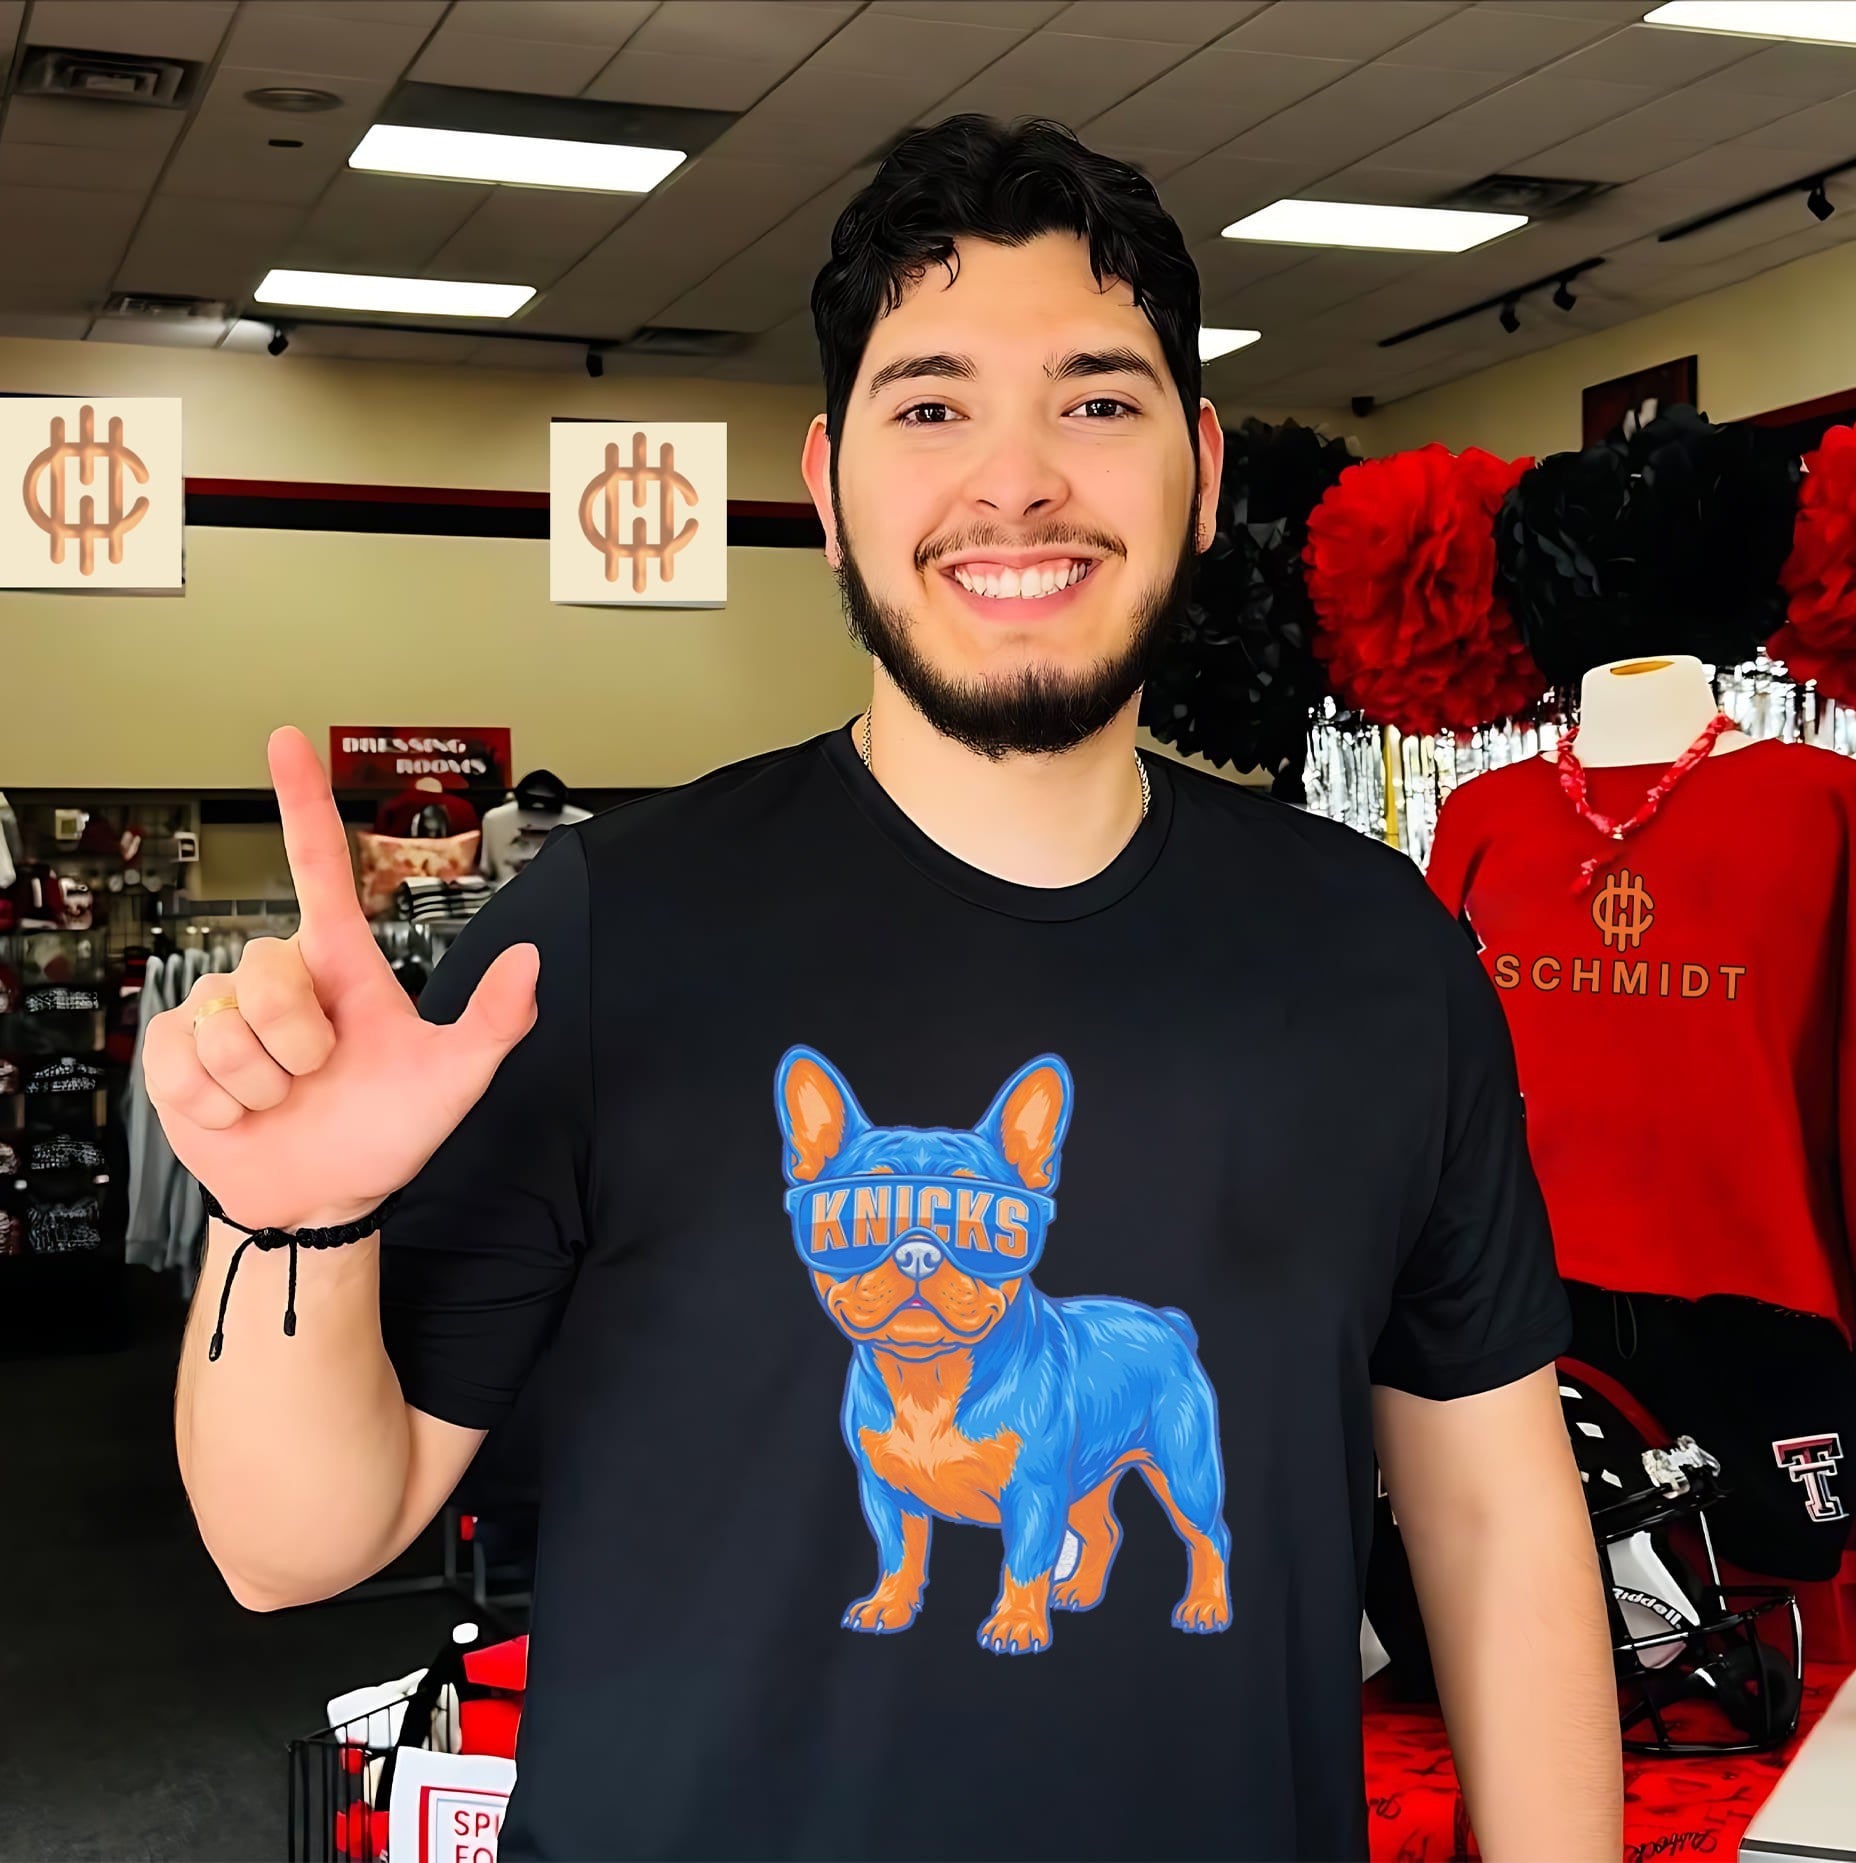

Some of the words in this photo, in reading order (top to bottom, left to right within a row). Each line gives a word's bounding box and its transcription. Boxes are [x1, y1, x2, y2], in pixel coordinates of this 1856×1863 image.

[342, 737, 467, 753] DRESSING
[396, 758, 487, 774] ROOMS
[1493, 953, 1747, 1001] SCHMIDT
[811, 1185, 1028, 1259] KNICKS
[1612, 1588, 1682, 1627] Riddell
